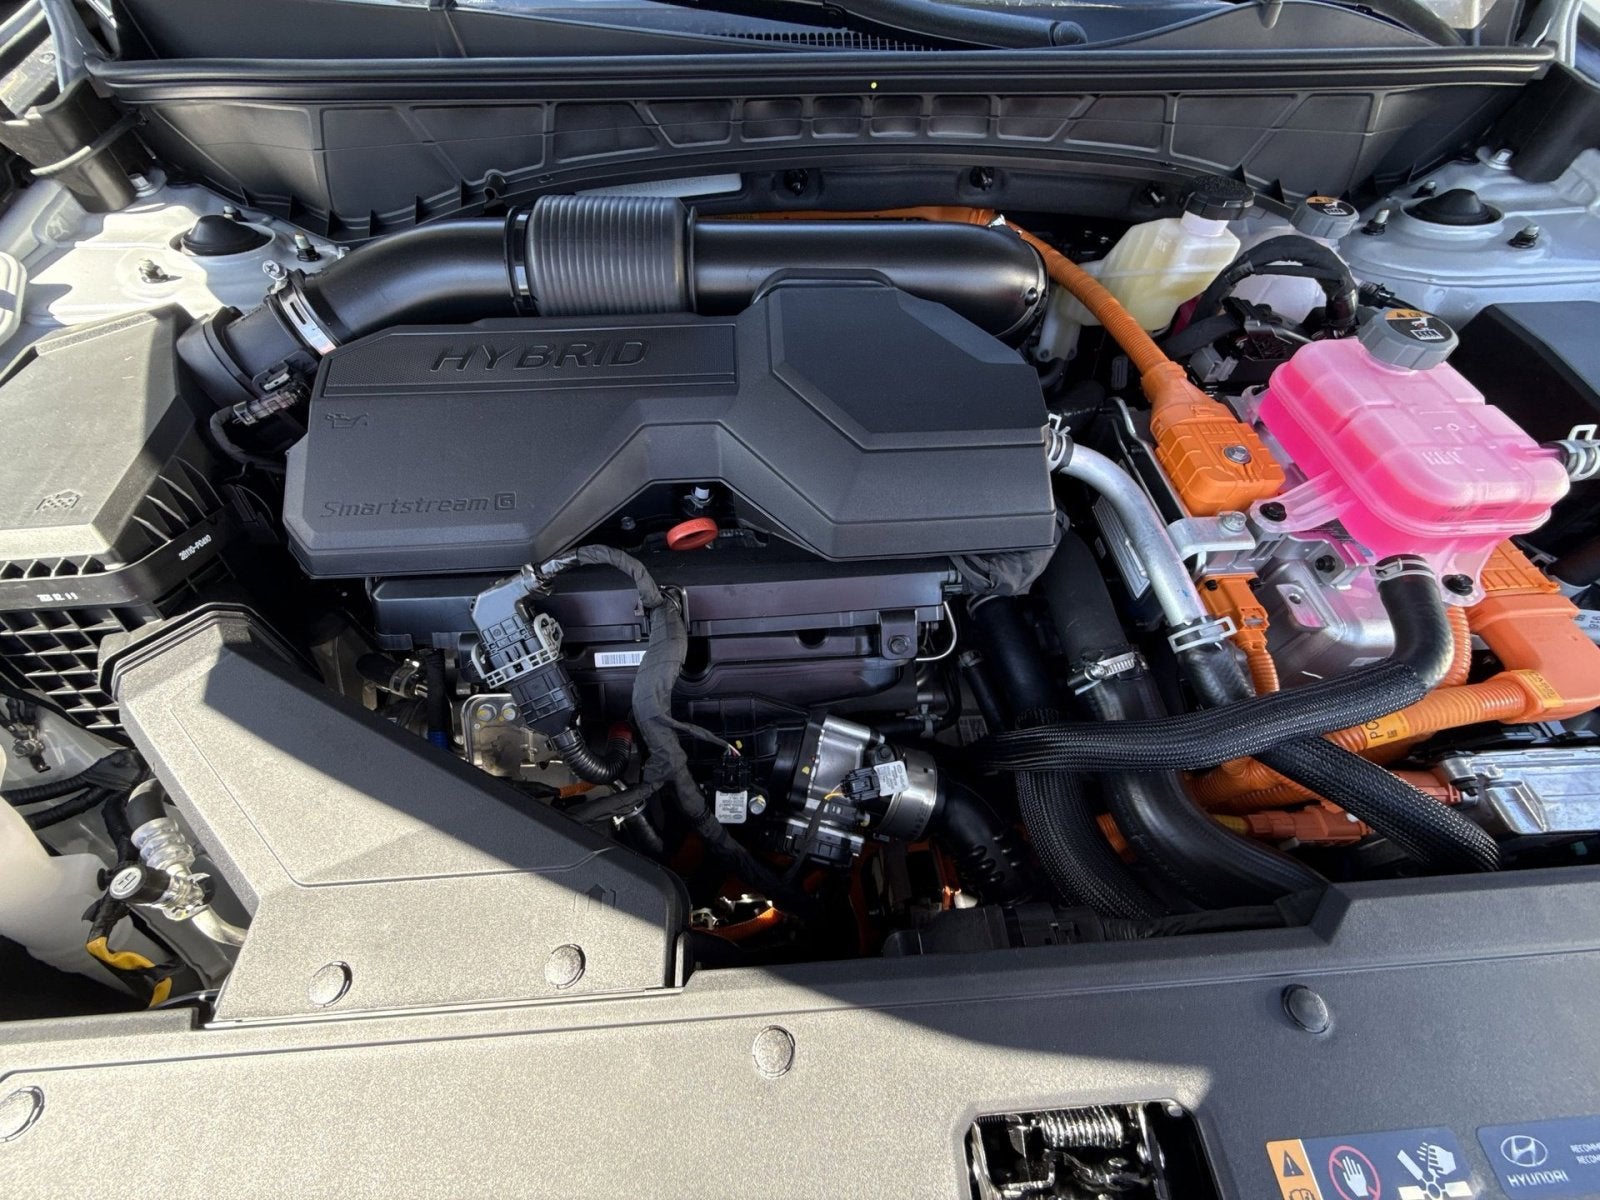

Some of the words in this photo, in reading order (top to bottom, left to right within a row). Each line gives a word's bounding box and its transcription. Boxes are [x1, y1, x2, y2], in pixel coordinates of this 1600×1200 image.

[430, 340, 649, 372] HYBRID
[320, 496, 490, 518] Smartstream
[1506, 1169, 1569, 1188] HYUNDAI
